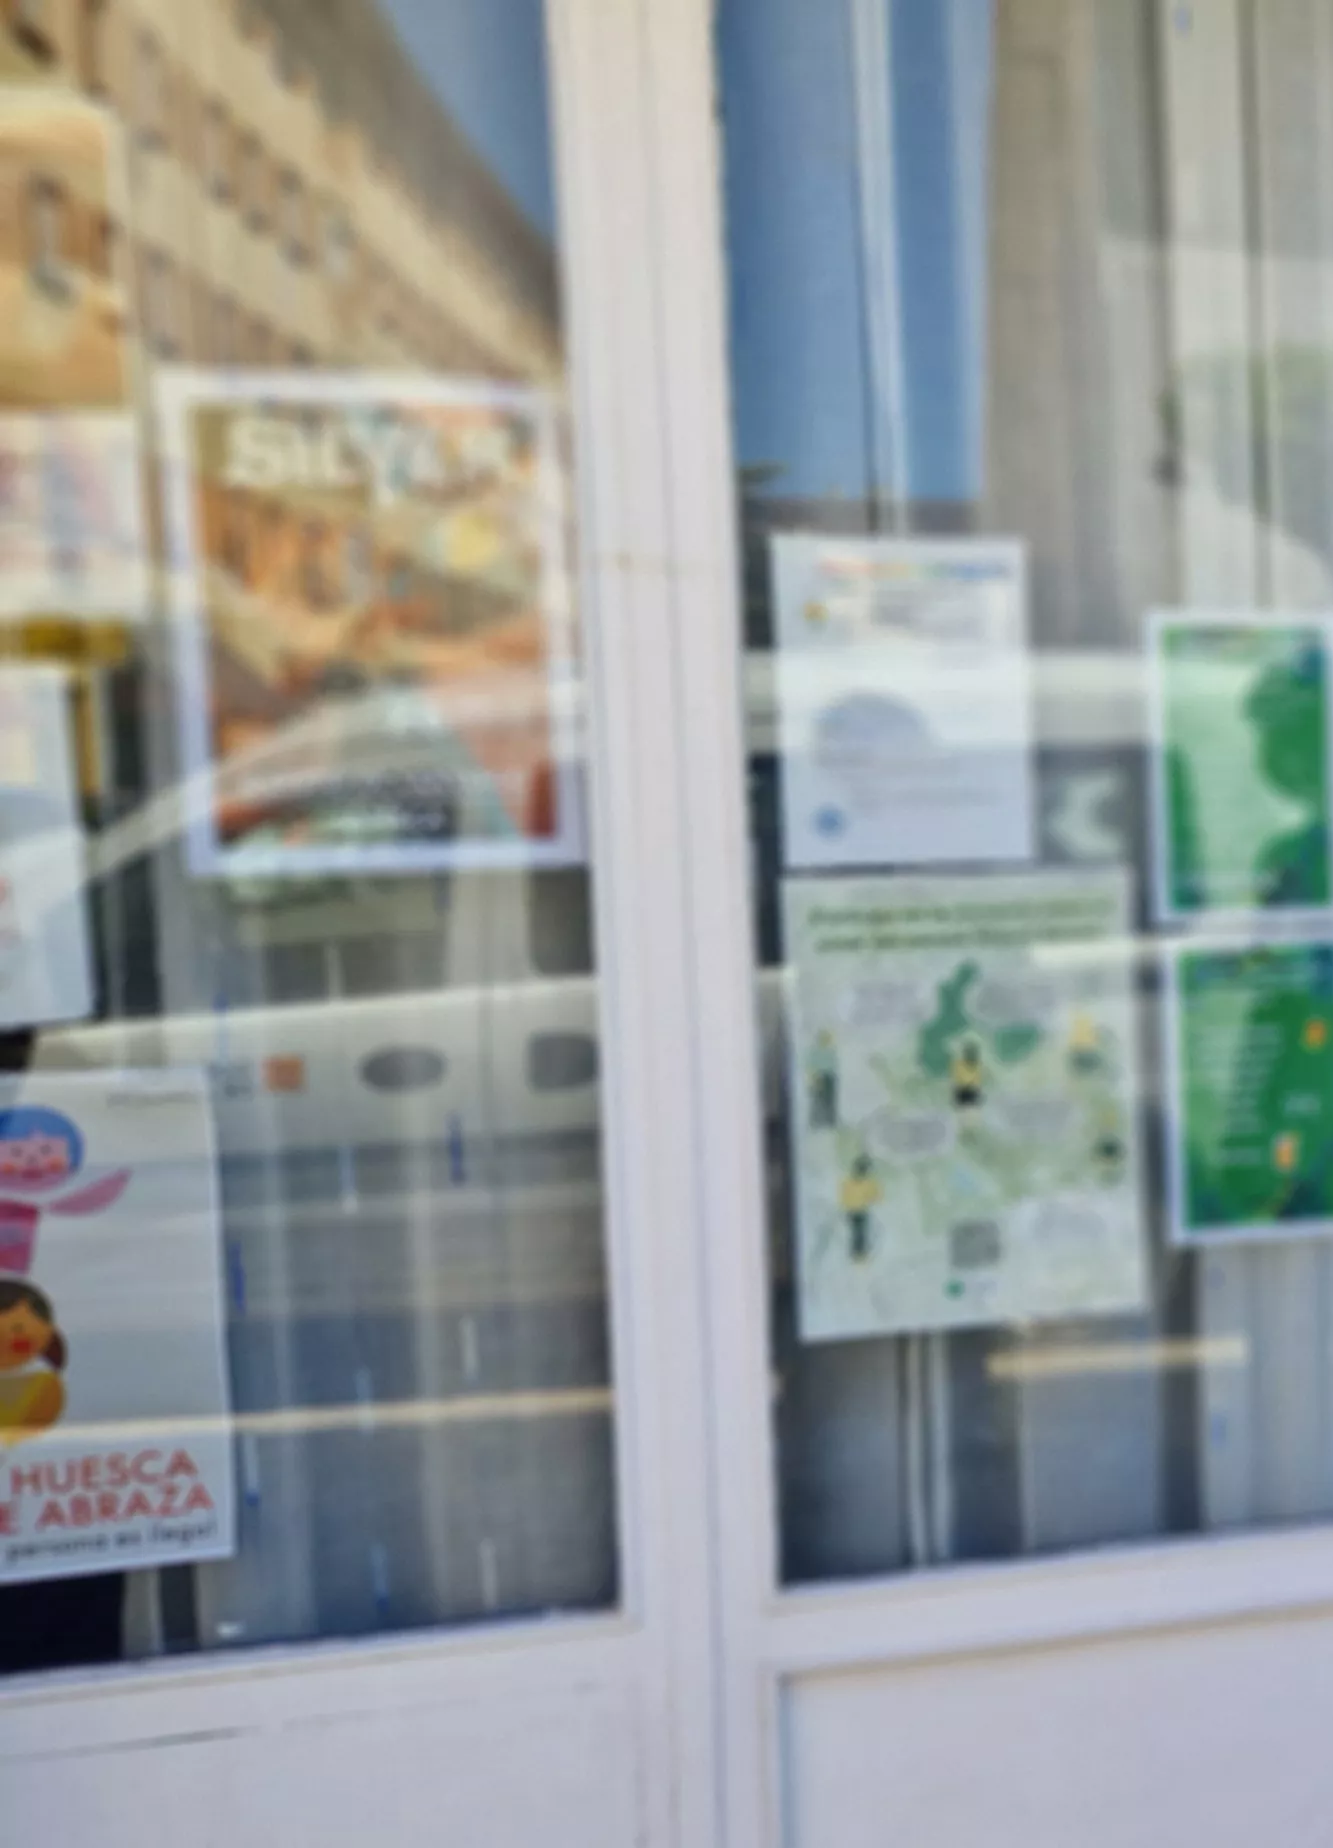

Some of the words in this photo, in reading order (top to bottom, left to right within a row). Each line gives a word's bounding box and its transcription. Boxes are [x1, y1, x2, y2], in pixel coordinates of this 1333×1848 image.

[10, 1448, 198, 1494] HUESCA
[35, 1482, 215, 1533] ABRAZA
[6, 1532, 108, 1566] persona
